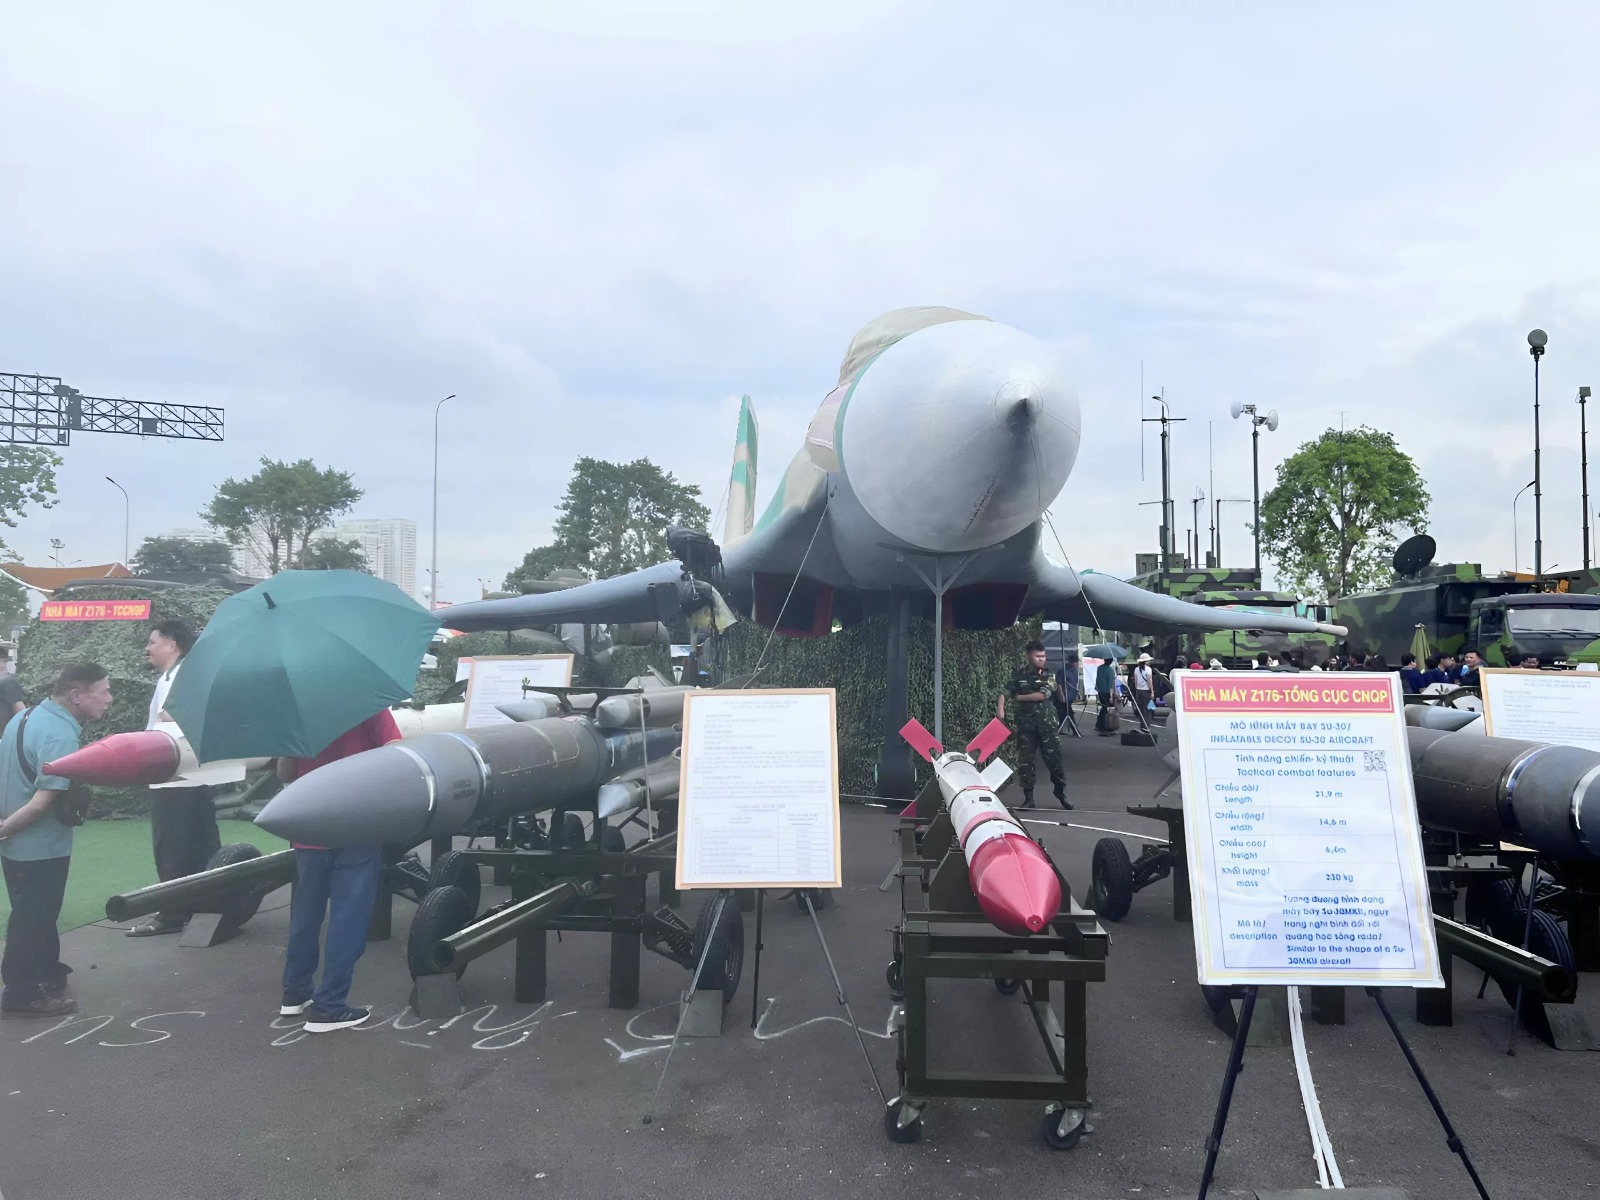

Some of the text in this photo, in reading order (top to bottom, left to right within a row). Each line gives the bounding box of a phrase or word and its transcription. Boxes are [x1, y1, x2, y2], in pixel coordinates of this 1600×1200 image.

[1190, 684, 1388, 704] NHÀ MÁY Z176-TỔNG CỤC CNQP
[1276, 720, 1296, 730] MÁY
[1300, 722, 1318, 730] BAY
[1210, 735, 1374, 744] INFLATABLE DECOY SU-30 AIRCRAFT
[1238, 768, 1356, 777] Tactical combat features
